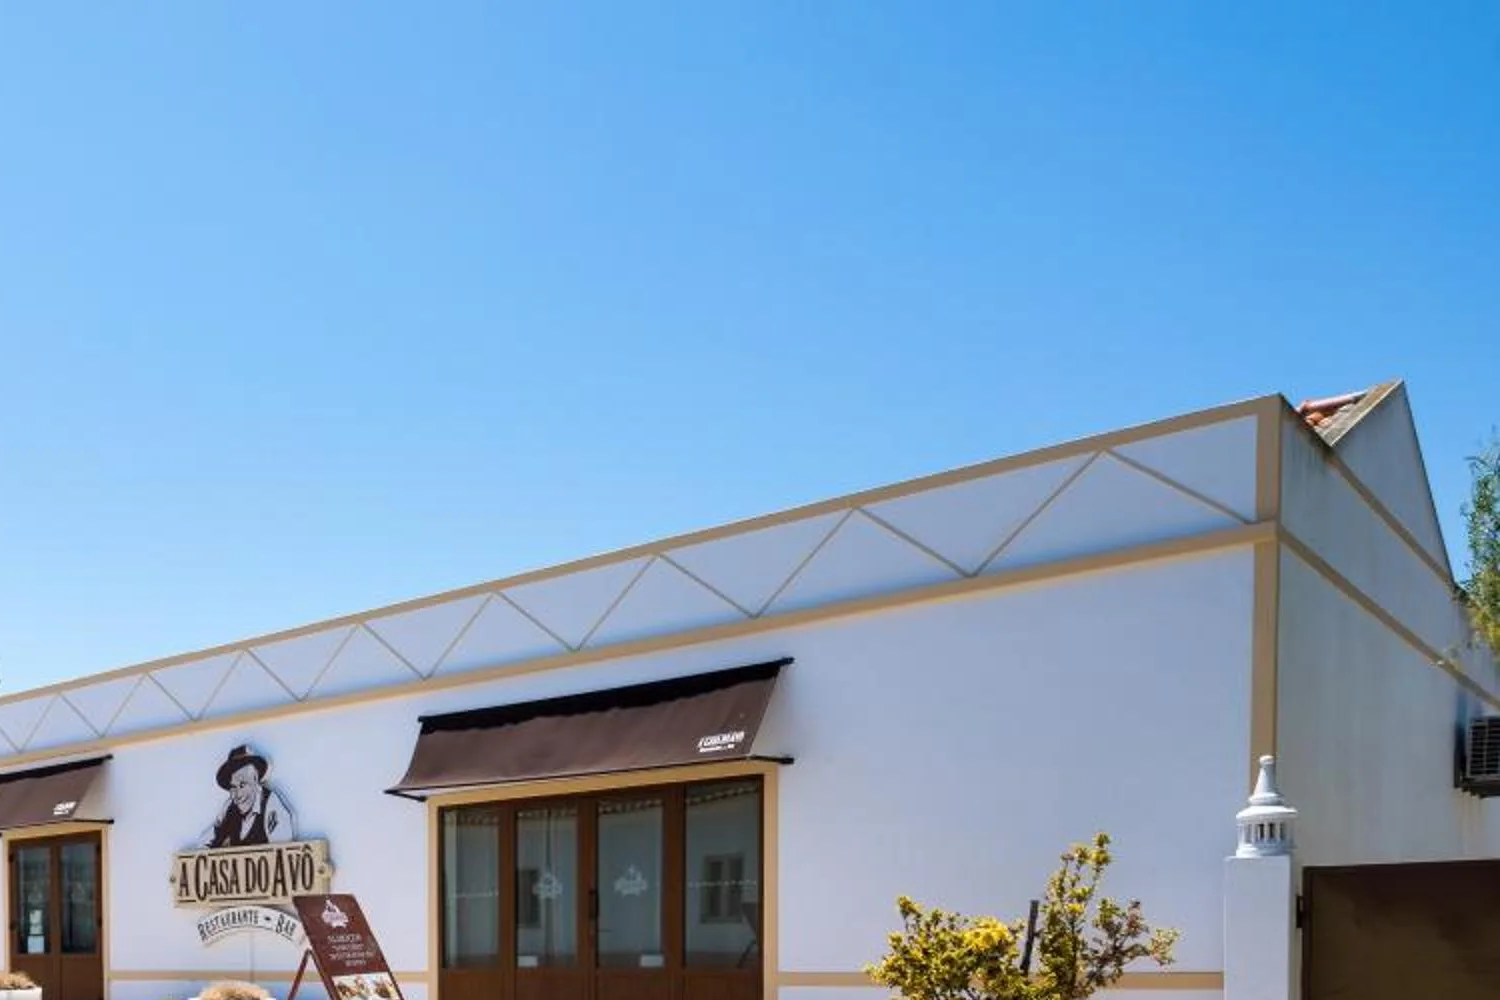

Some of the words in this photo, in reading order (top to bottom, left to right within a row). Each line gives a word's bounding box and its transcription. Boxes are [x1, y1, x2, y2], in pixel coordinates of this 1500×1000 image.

[178, 861, 189, 897] A
[195, 855, 241, 901] CASA
[244, 856, 270, 893] DO
